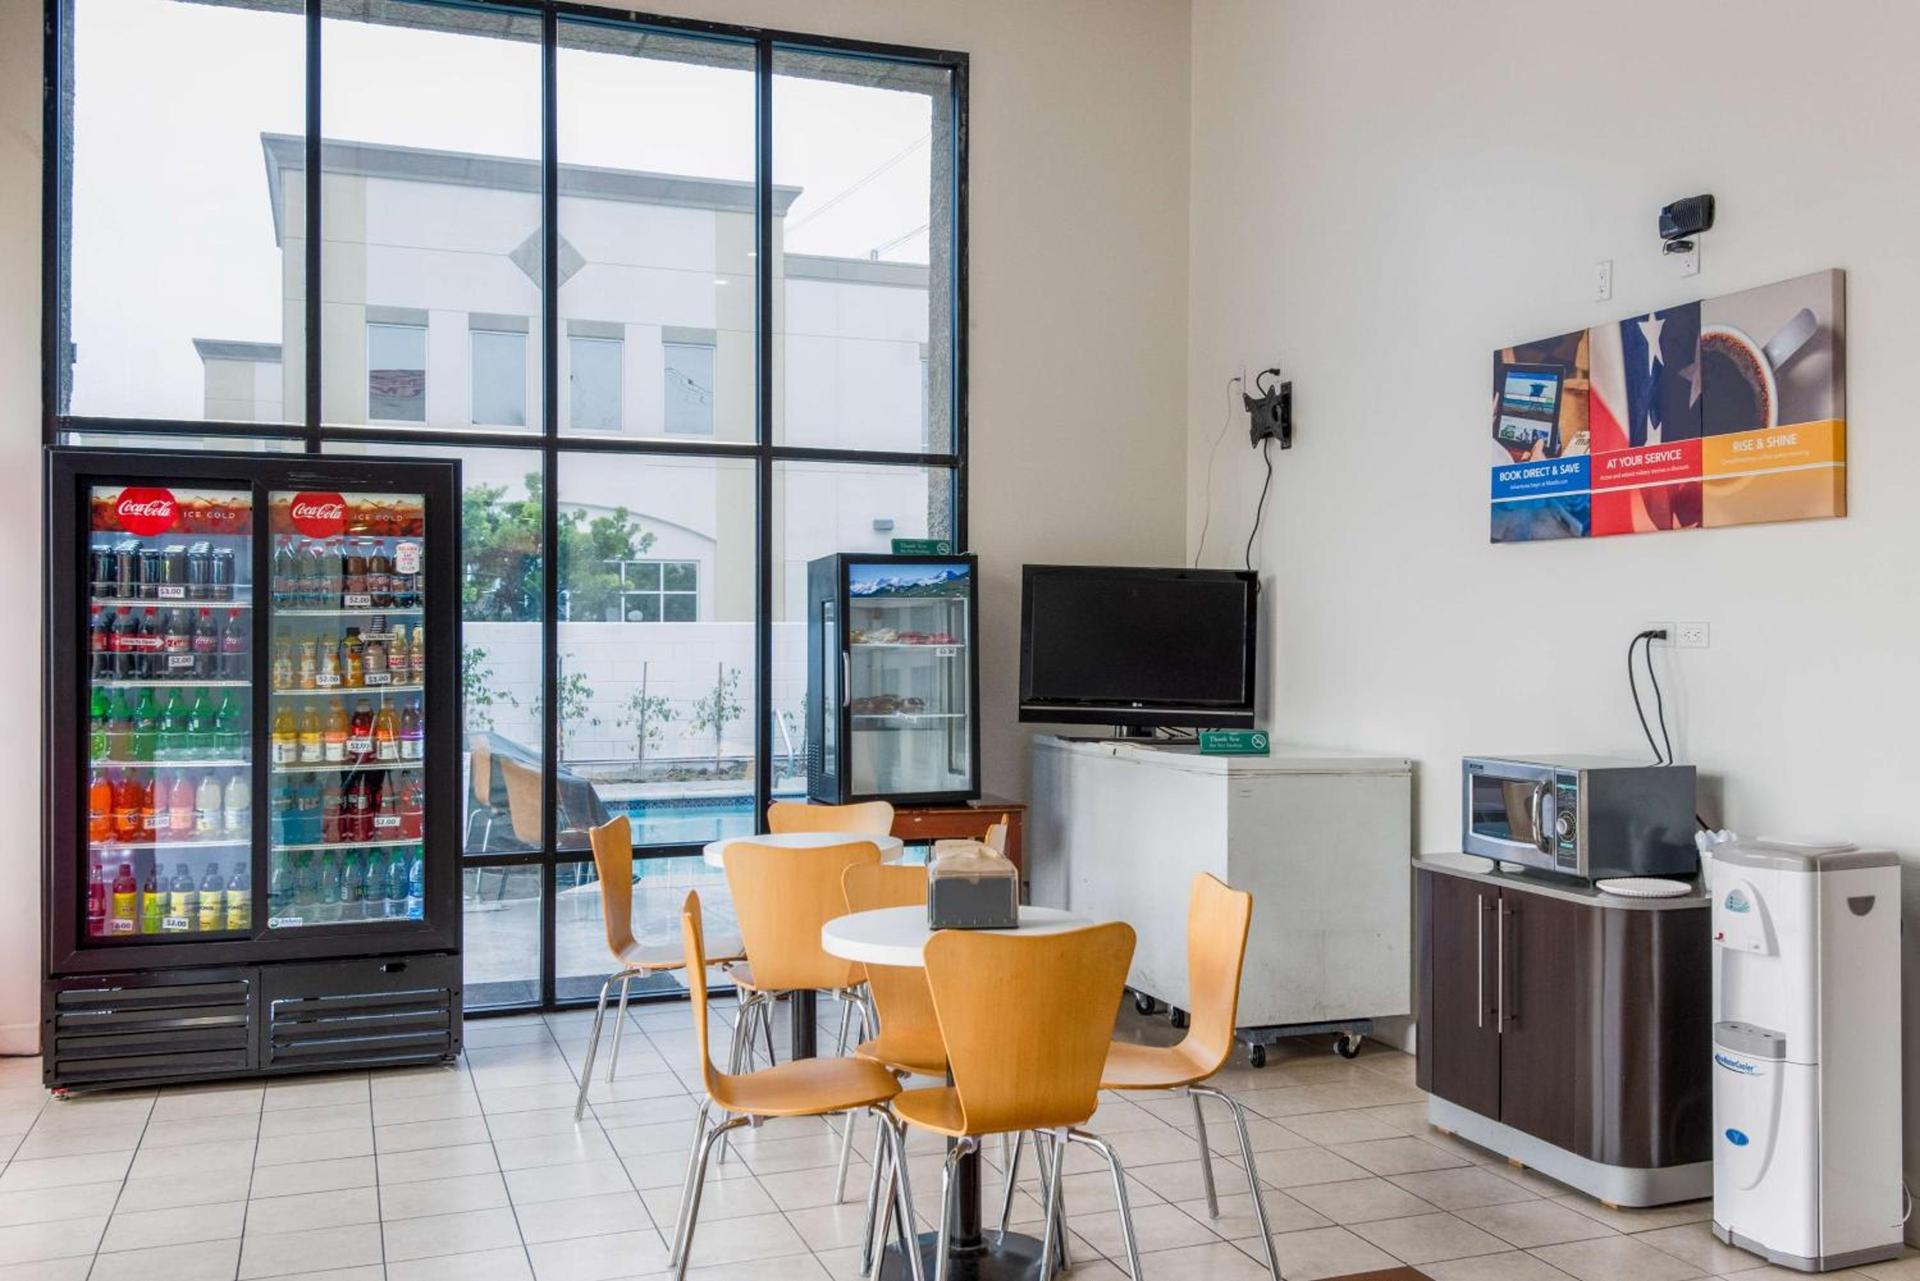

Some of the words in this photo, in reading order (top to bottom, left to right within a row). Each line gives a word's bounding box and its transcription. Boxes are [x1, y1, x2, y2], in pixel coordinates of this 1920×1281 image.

[1732, 440, 1754, 452] RISE
[1757, 438, 1765, 449] &
[1766, 433, 1798, 448] SHINE
[1606, 458, 1617, 469] AT
[1620, 455, 1643, 468] YOUR
[1644, 449, 1682, 464] SERVICE
[1499, 470, 1522, 482] BOOK
[1523, 466, 1551, 479] DIRECT
[1551, 465, 1559, 476] &
[1560, 462, 1581, 475] SAVE
[118, 499, 174, 517] Coca-Cola
[292, 502, 345, 520] Coca-Cola
